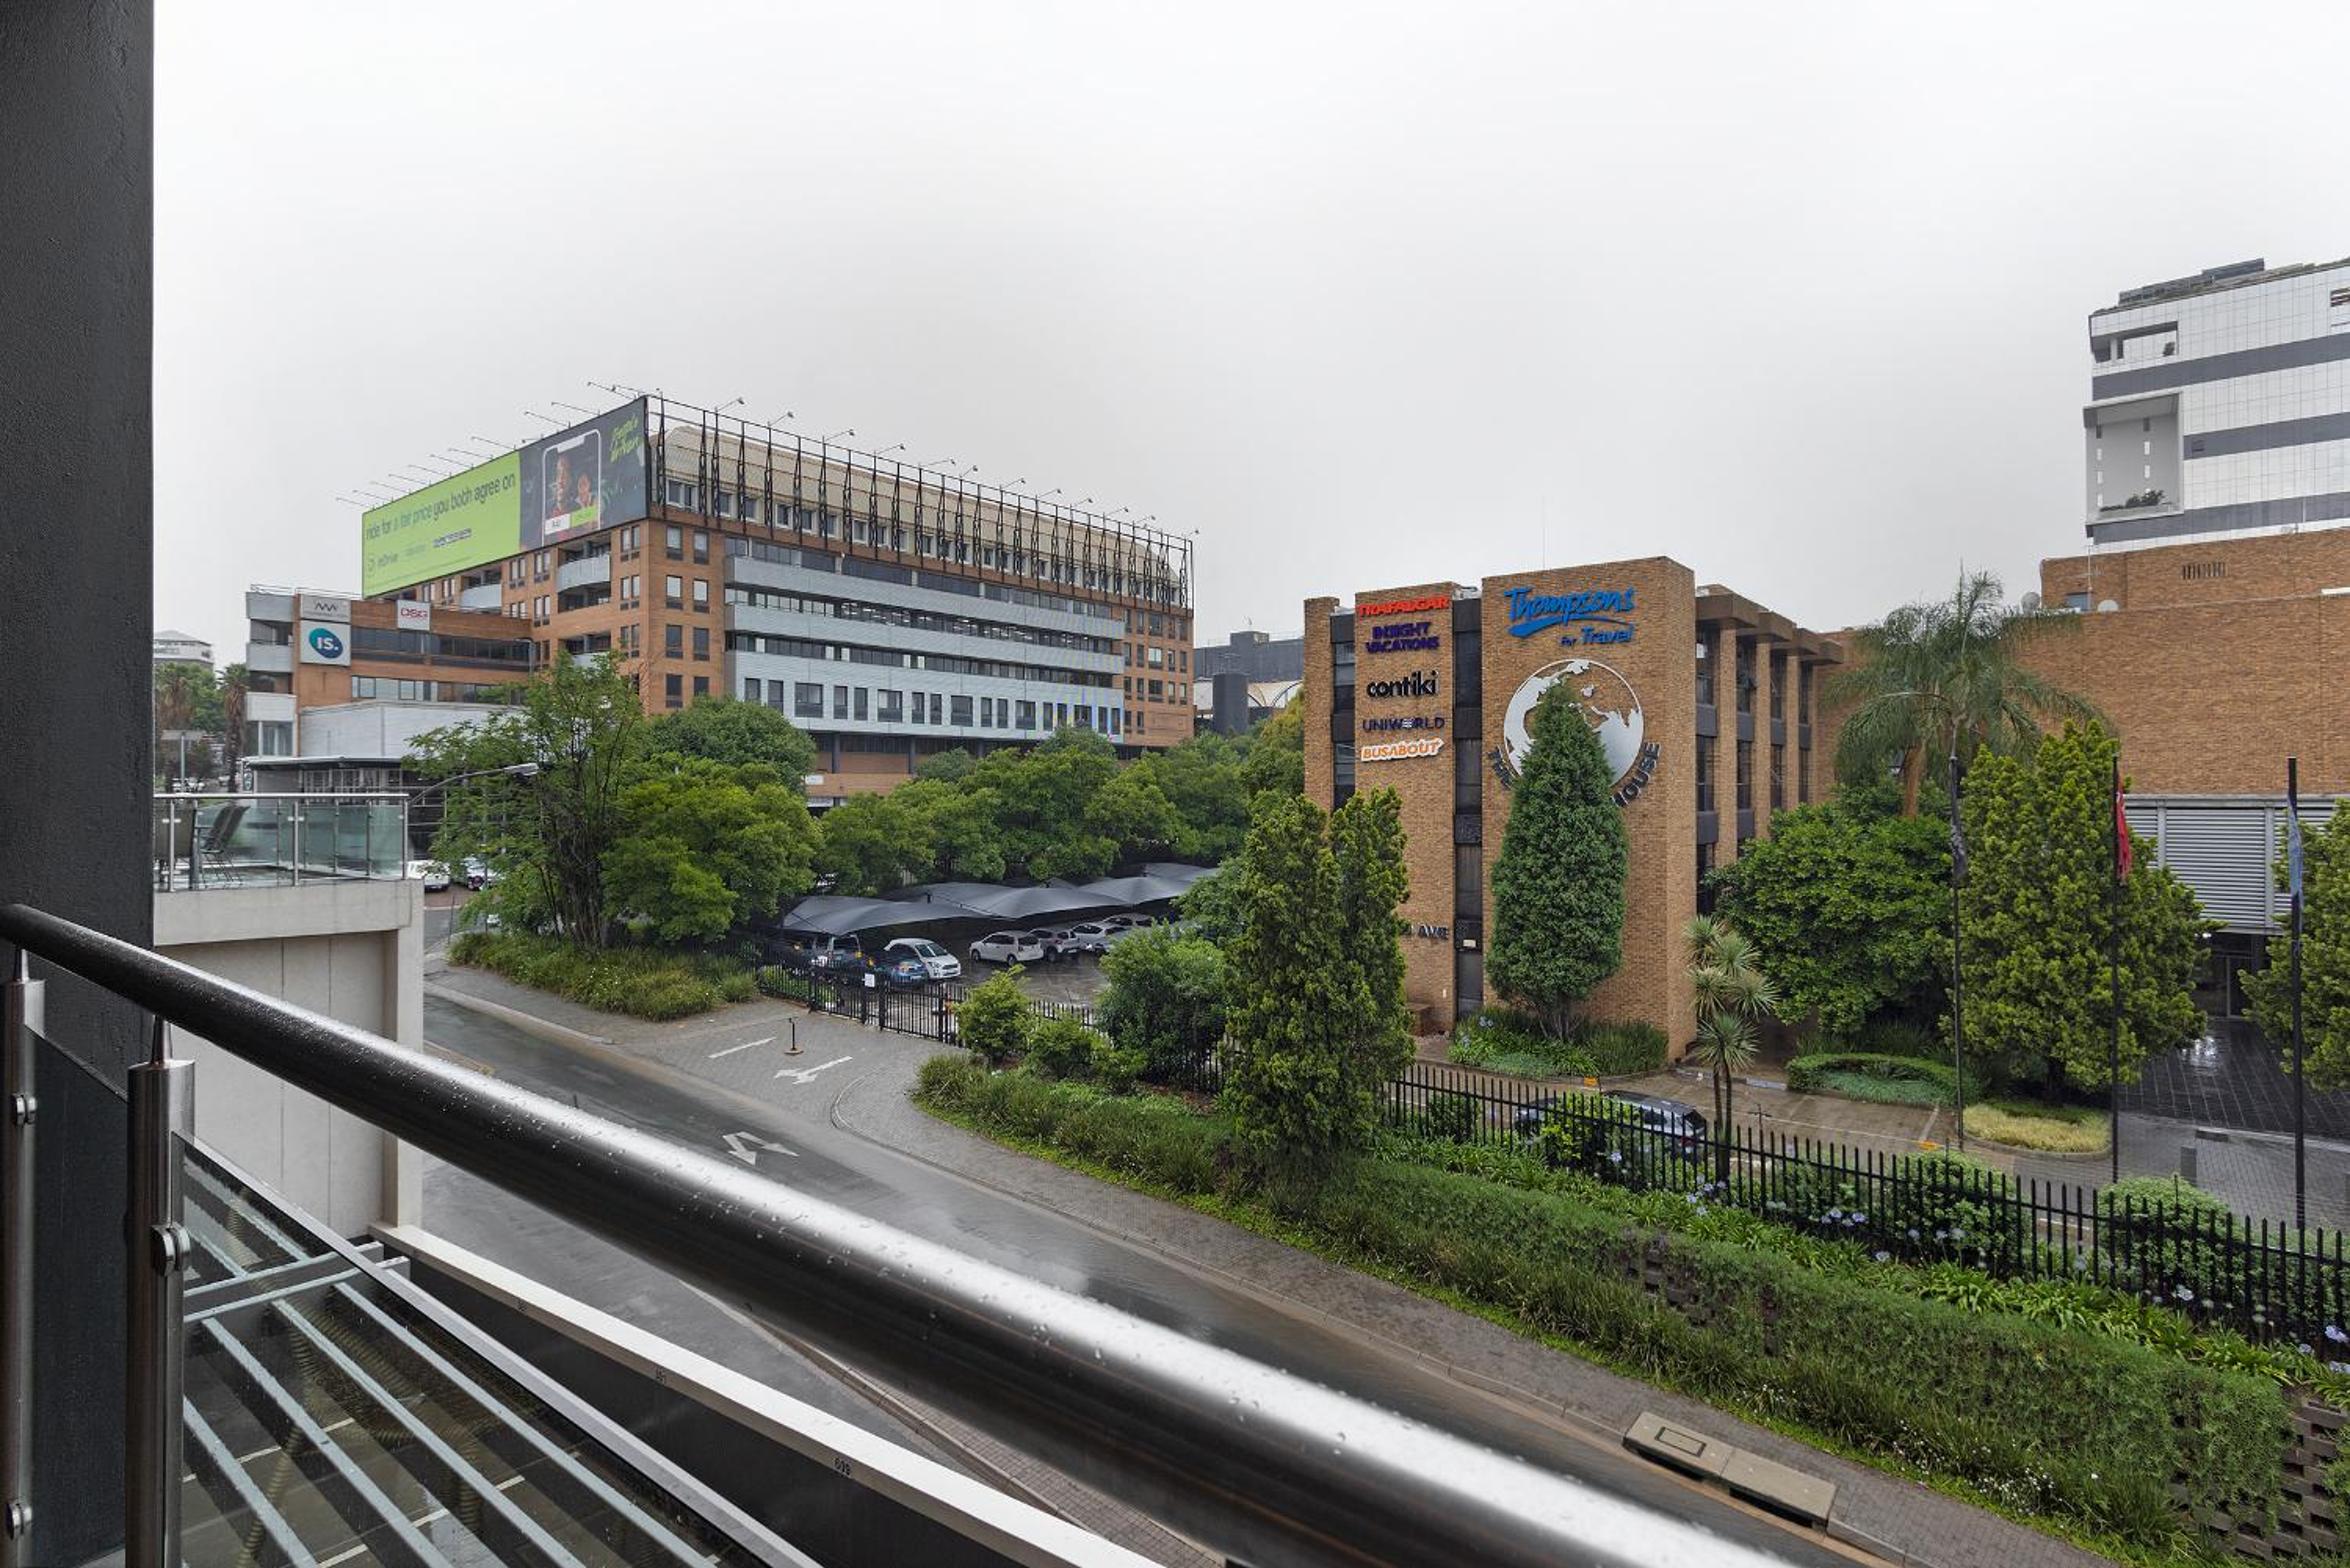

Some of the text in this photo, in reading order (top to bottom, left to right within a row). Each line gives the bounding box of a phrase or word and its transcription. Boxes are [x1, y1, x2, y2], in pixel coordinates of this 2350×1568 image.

[433, 500, 450, 521] you
[450, 487, 473, 510] both
[474, 478, 501, 504] agree
[502, 473, 516, 490] on
[1367, 670, 1437, 697] contiki
[1362, 739, 1442, 759] BUSABOUT
